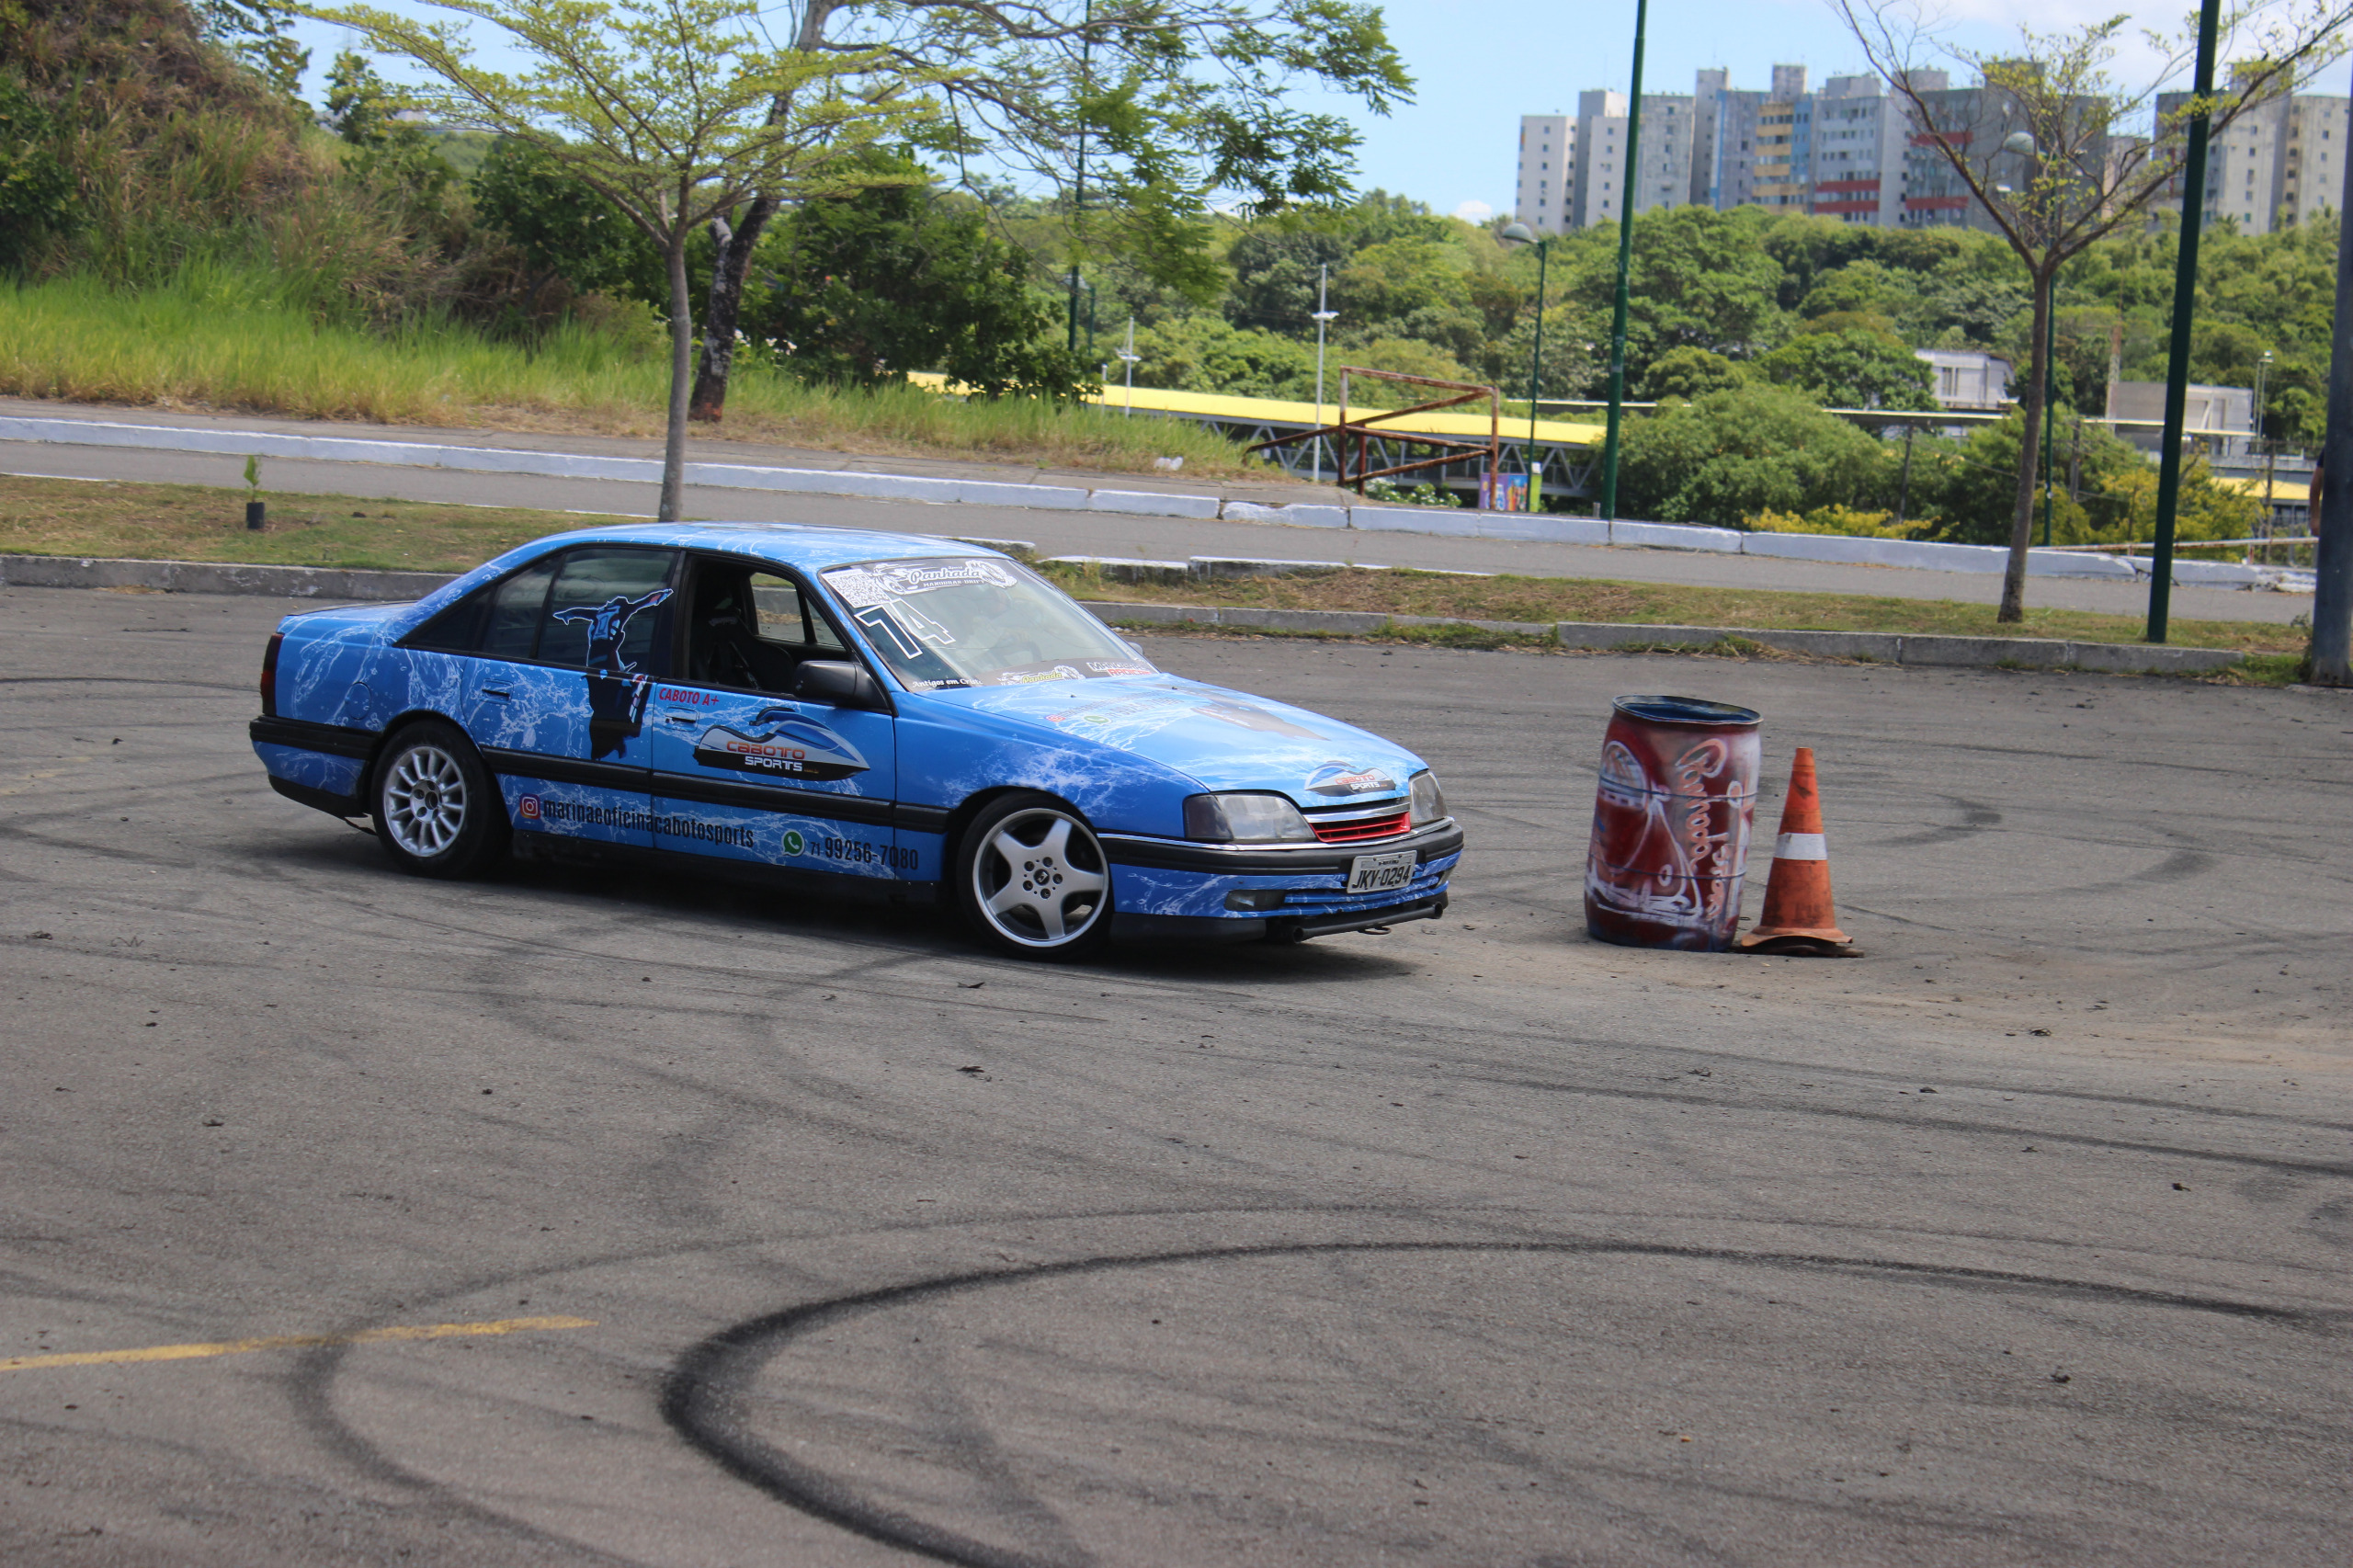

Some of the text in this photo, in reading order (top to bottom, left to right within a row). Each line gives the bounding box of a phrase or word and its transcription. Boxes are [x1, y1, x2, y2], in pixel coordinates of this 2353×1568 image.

[909, 567, 981, 584] Panhada
[659, 687, 720, 706] CABOTO A+
[745, 756, 803, 772] SPORTS
[1350, 781, 1381, 790] SPORTS
[543, 800, 754, 847] marinaeoficinacabotosports
[810, 836, 918, 870] 71 99256-7080
